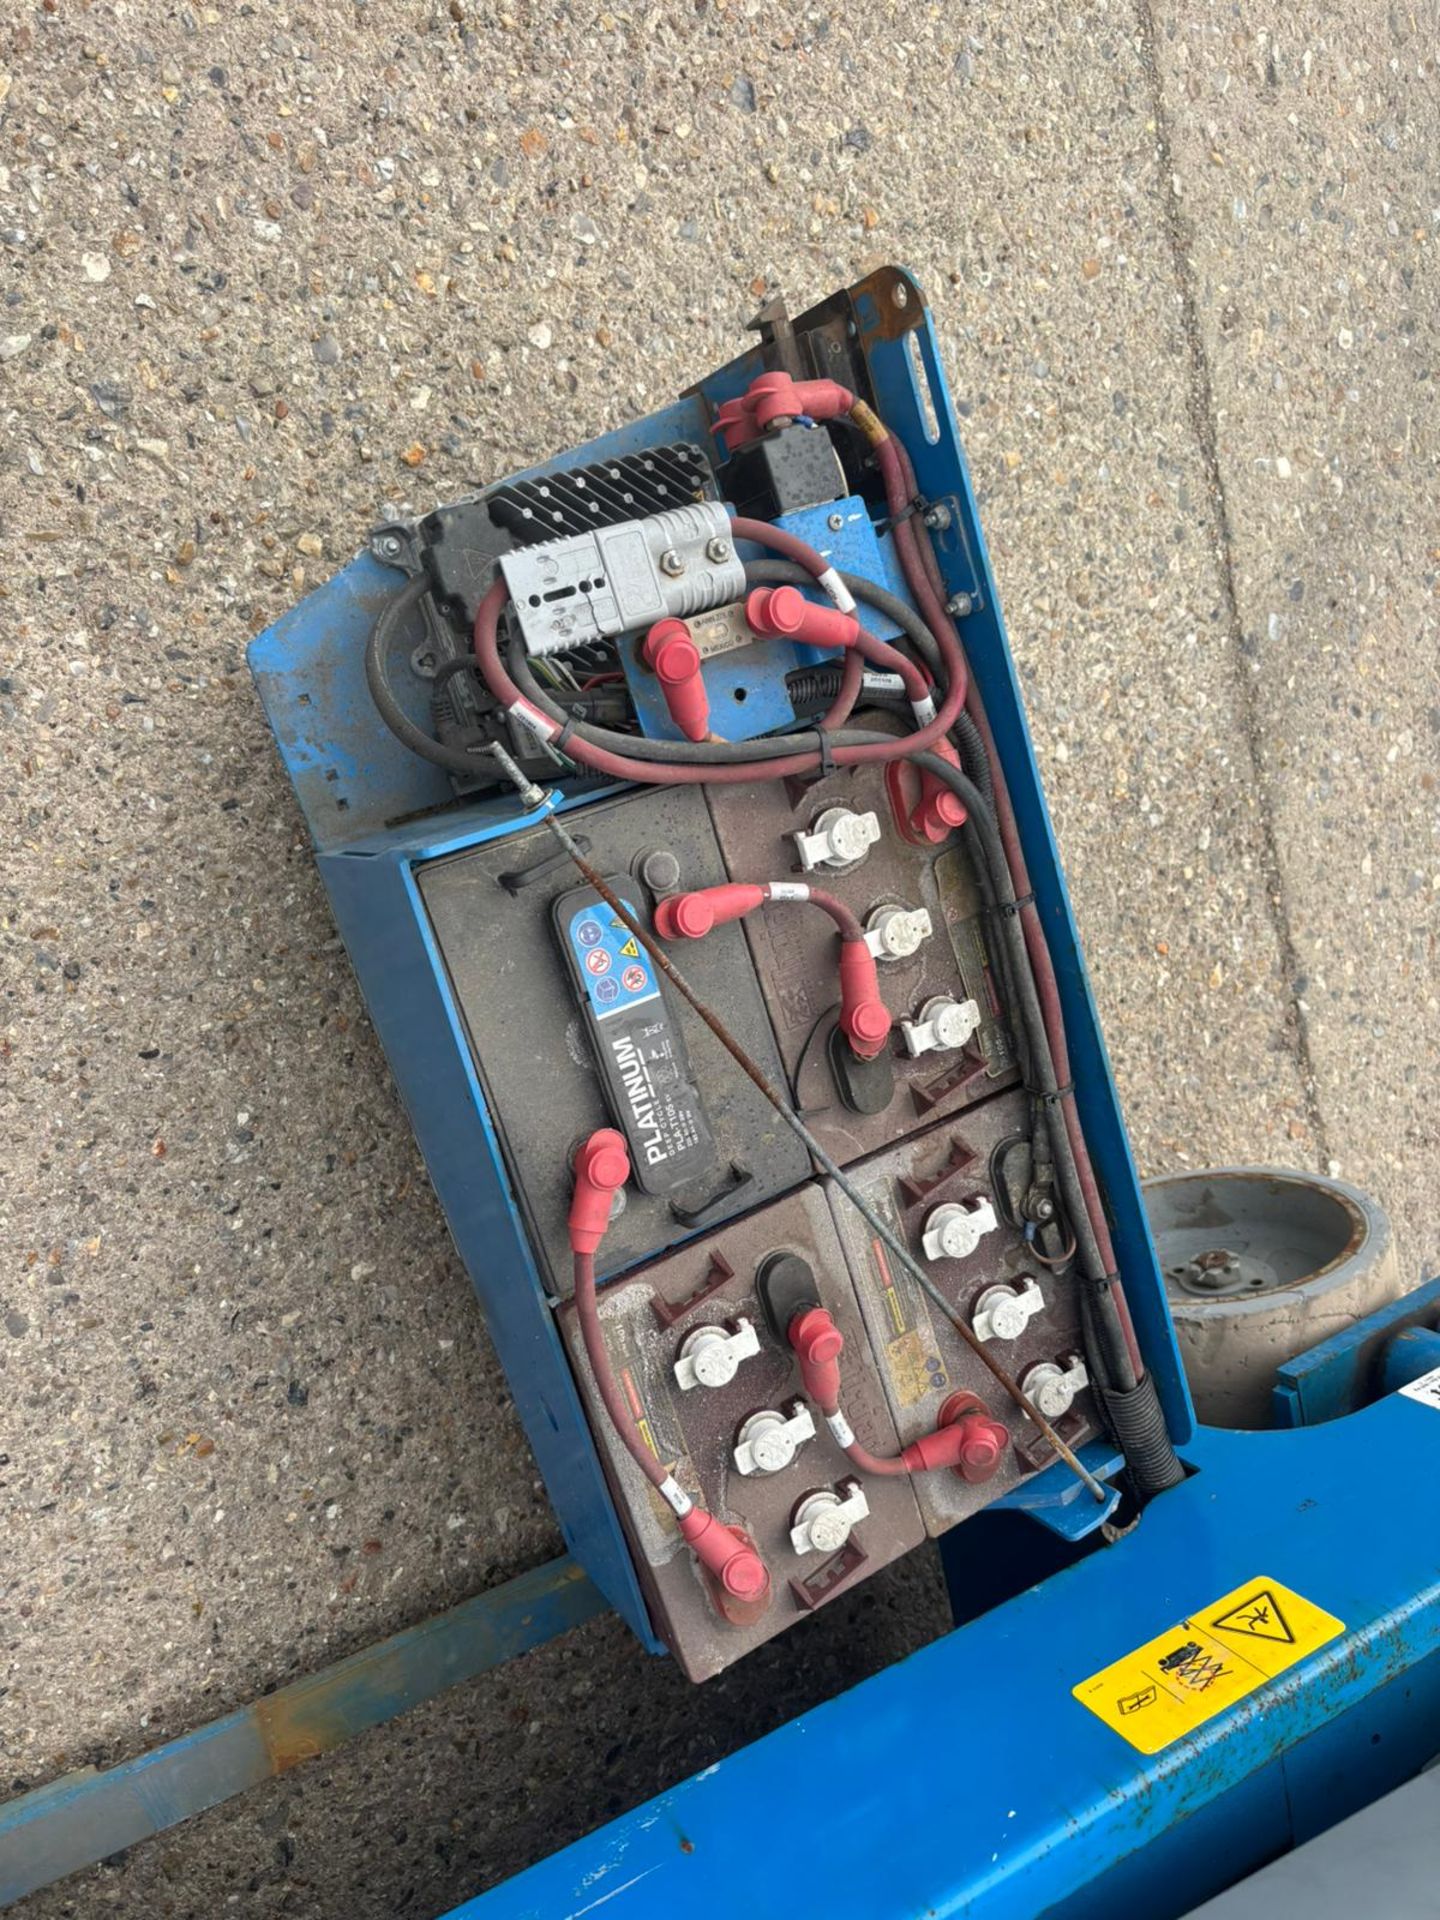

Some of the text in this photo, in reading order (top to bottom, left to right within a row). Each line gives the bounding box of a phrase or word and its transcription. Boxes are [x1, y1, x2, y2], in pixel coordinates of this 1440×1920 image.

[612, 1035, 668, 1165] PLATINUM
[653, 1099, 676, 1157] DEEP CYCLE
[665, 1103, 686, 1151] PLA-T105
